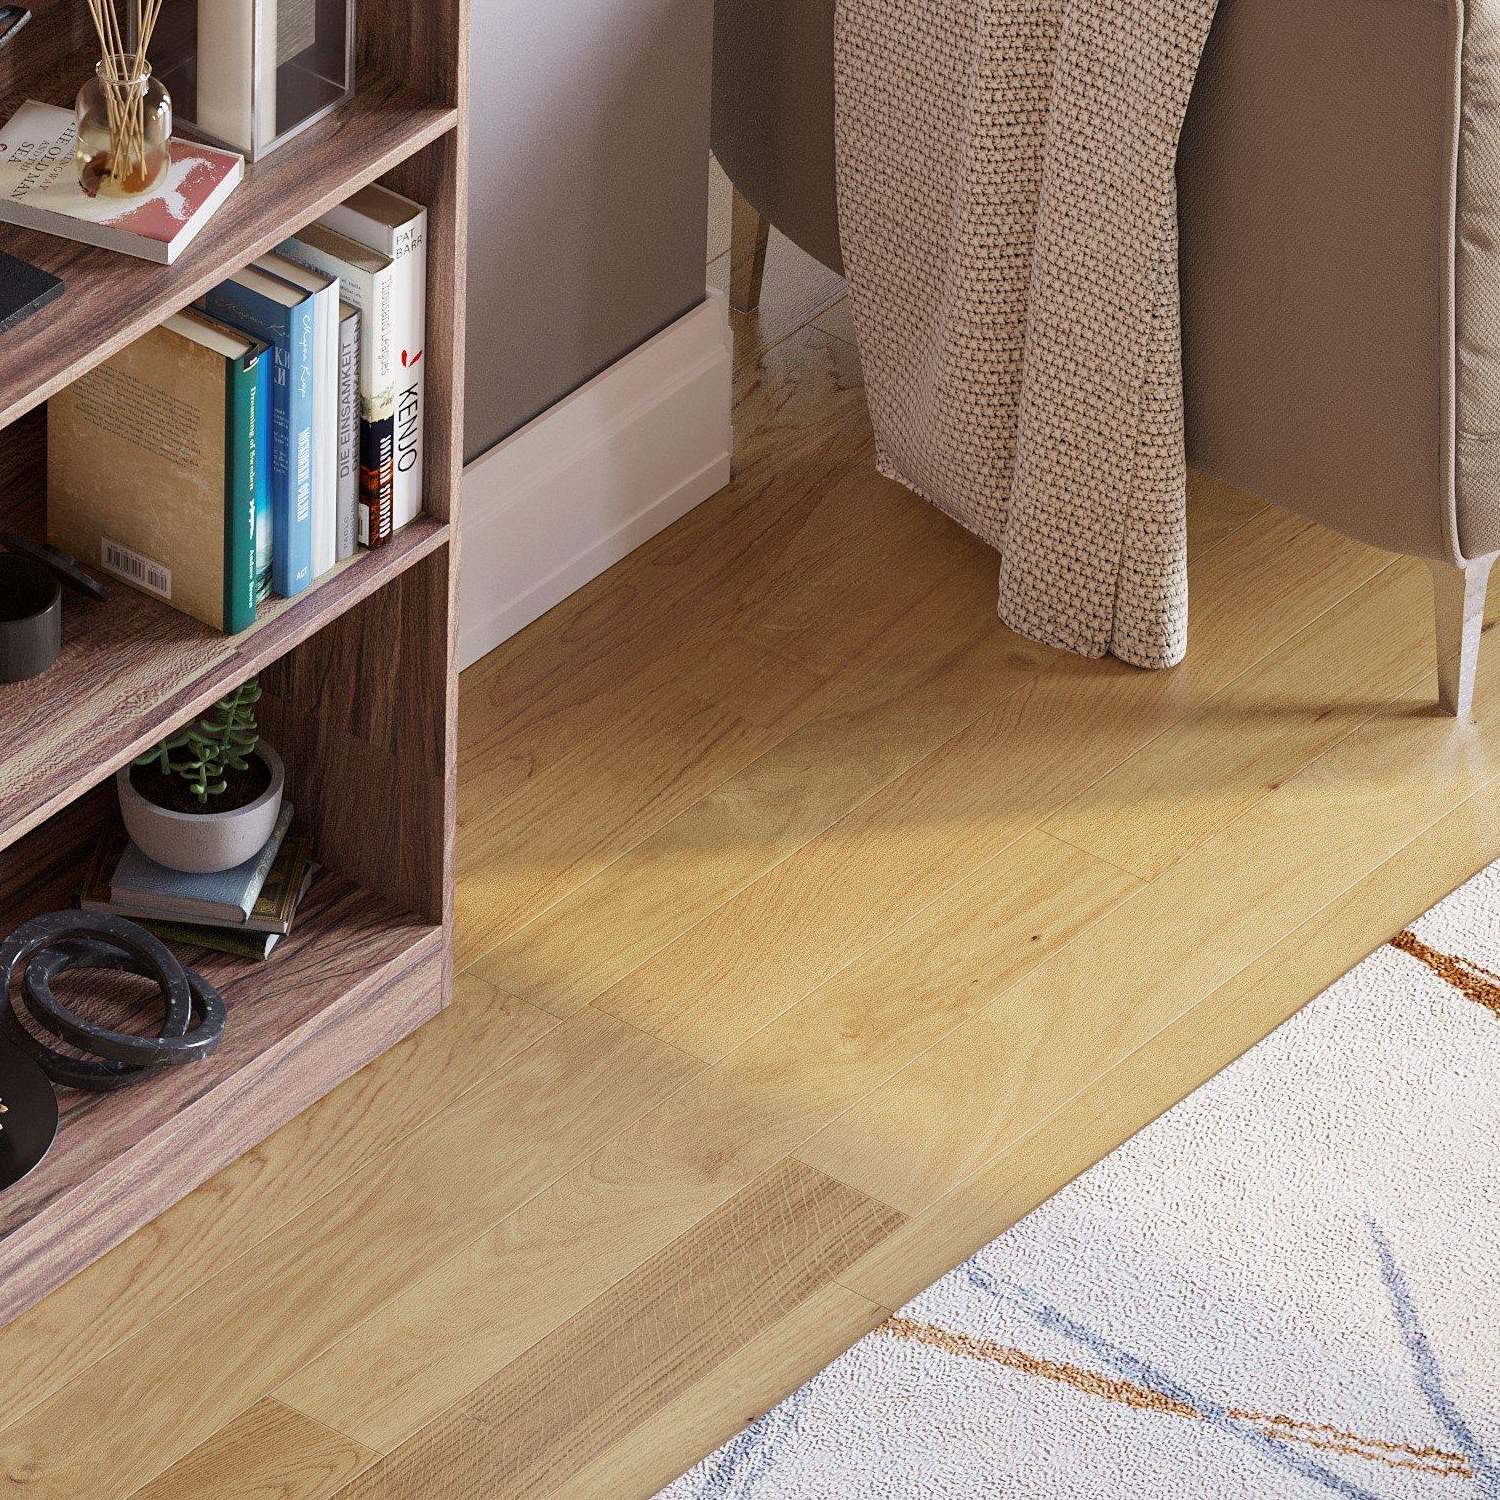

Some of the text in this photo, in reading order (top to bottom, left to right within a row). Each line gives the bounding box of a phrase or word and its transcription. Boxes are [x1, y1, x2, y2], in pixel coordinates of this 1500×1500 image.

[7, 141, 34, 162] SEA
[35, 146, 61, 171] OLD
[11, 172, 41, 200] MAN
[396, 227, 415, 245] PAT
[396, 234, 422, 259] BARR
[378, 275, 393, 376] Thousand Leagues
[340, 342, 351, 478] DIE EINSAMKEIT
[397, 382, 418, 472] KENJO
